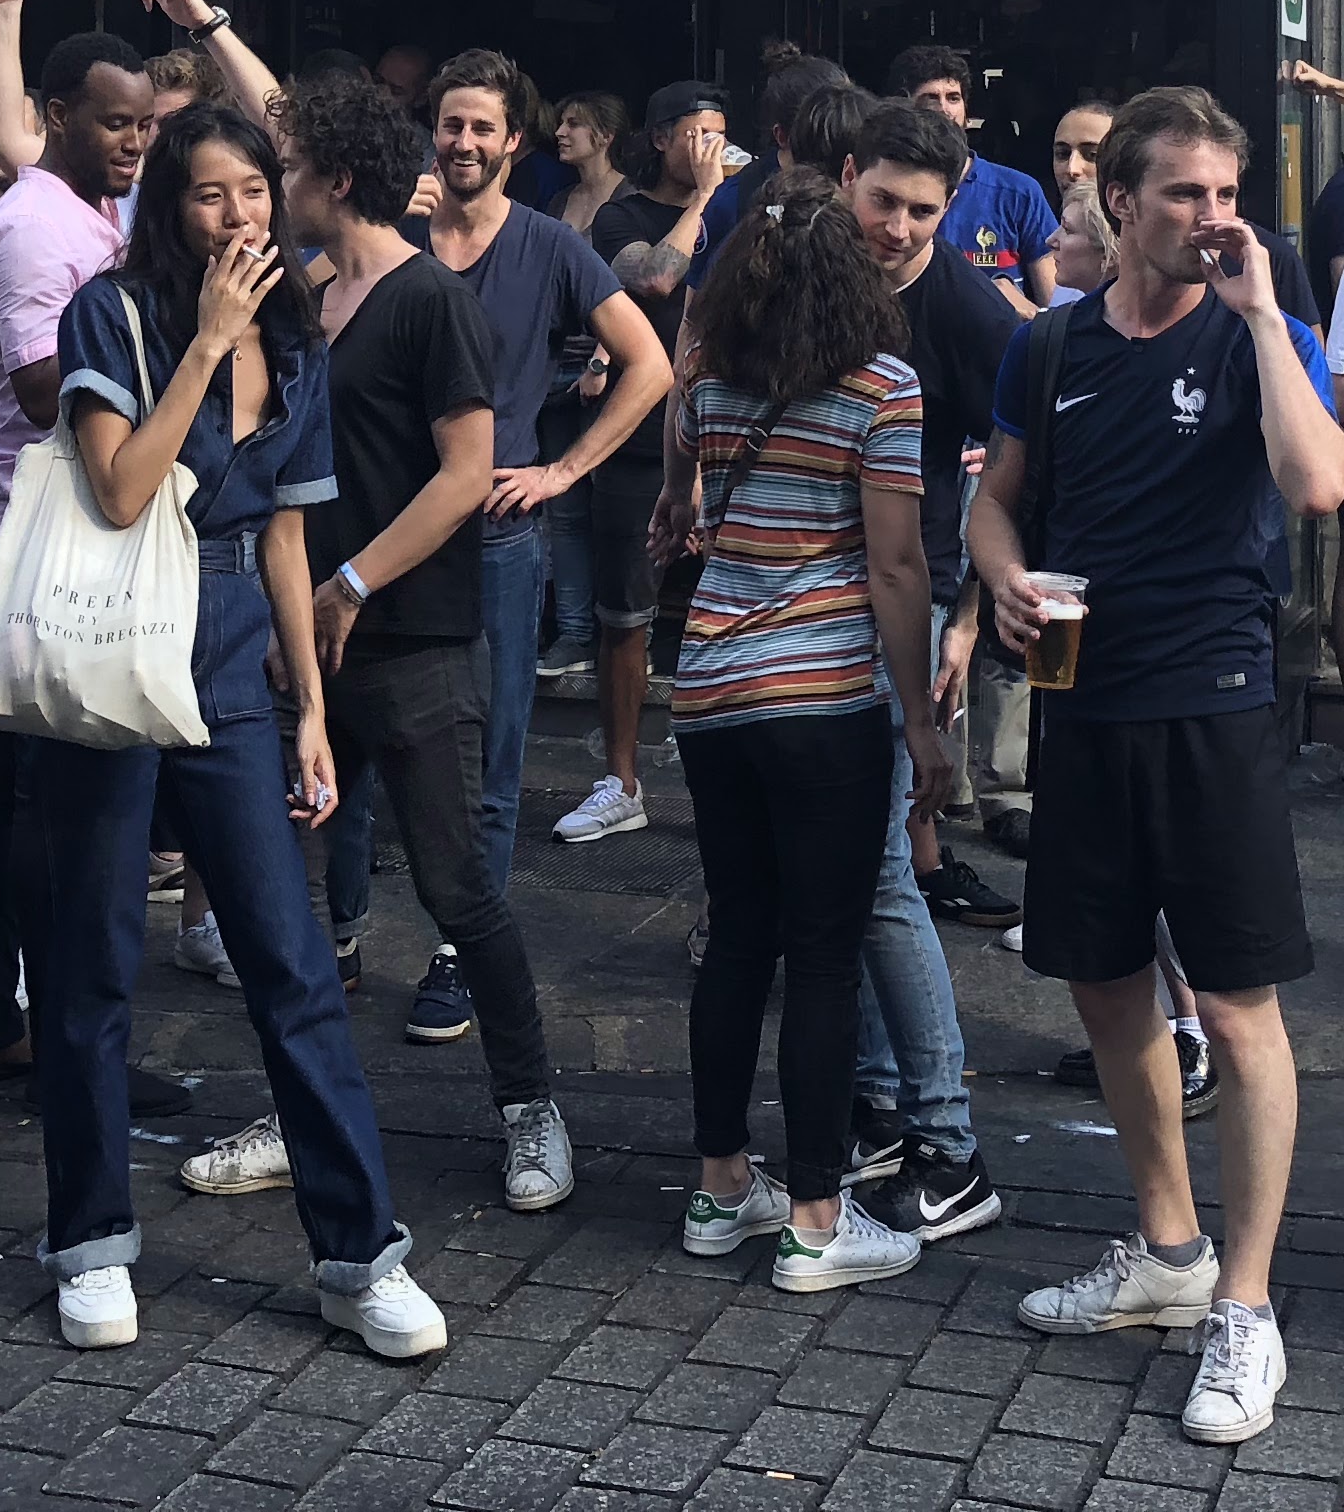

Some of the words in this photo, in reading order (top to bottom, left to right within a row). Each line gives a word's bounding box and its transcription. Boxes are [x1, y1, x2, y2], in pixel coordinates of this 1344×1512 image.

[52, 584, 134, 609] PREEN
[7, 612, 85, 643] THORNTON
[93, 621, 175, 646] BREGAZZI
[78, 614, 100, 626] BY
